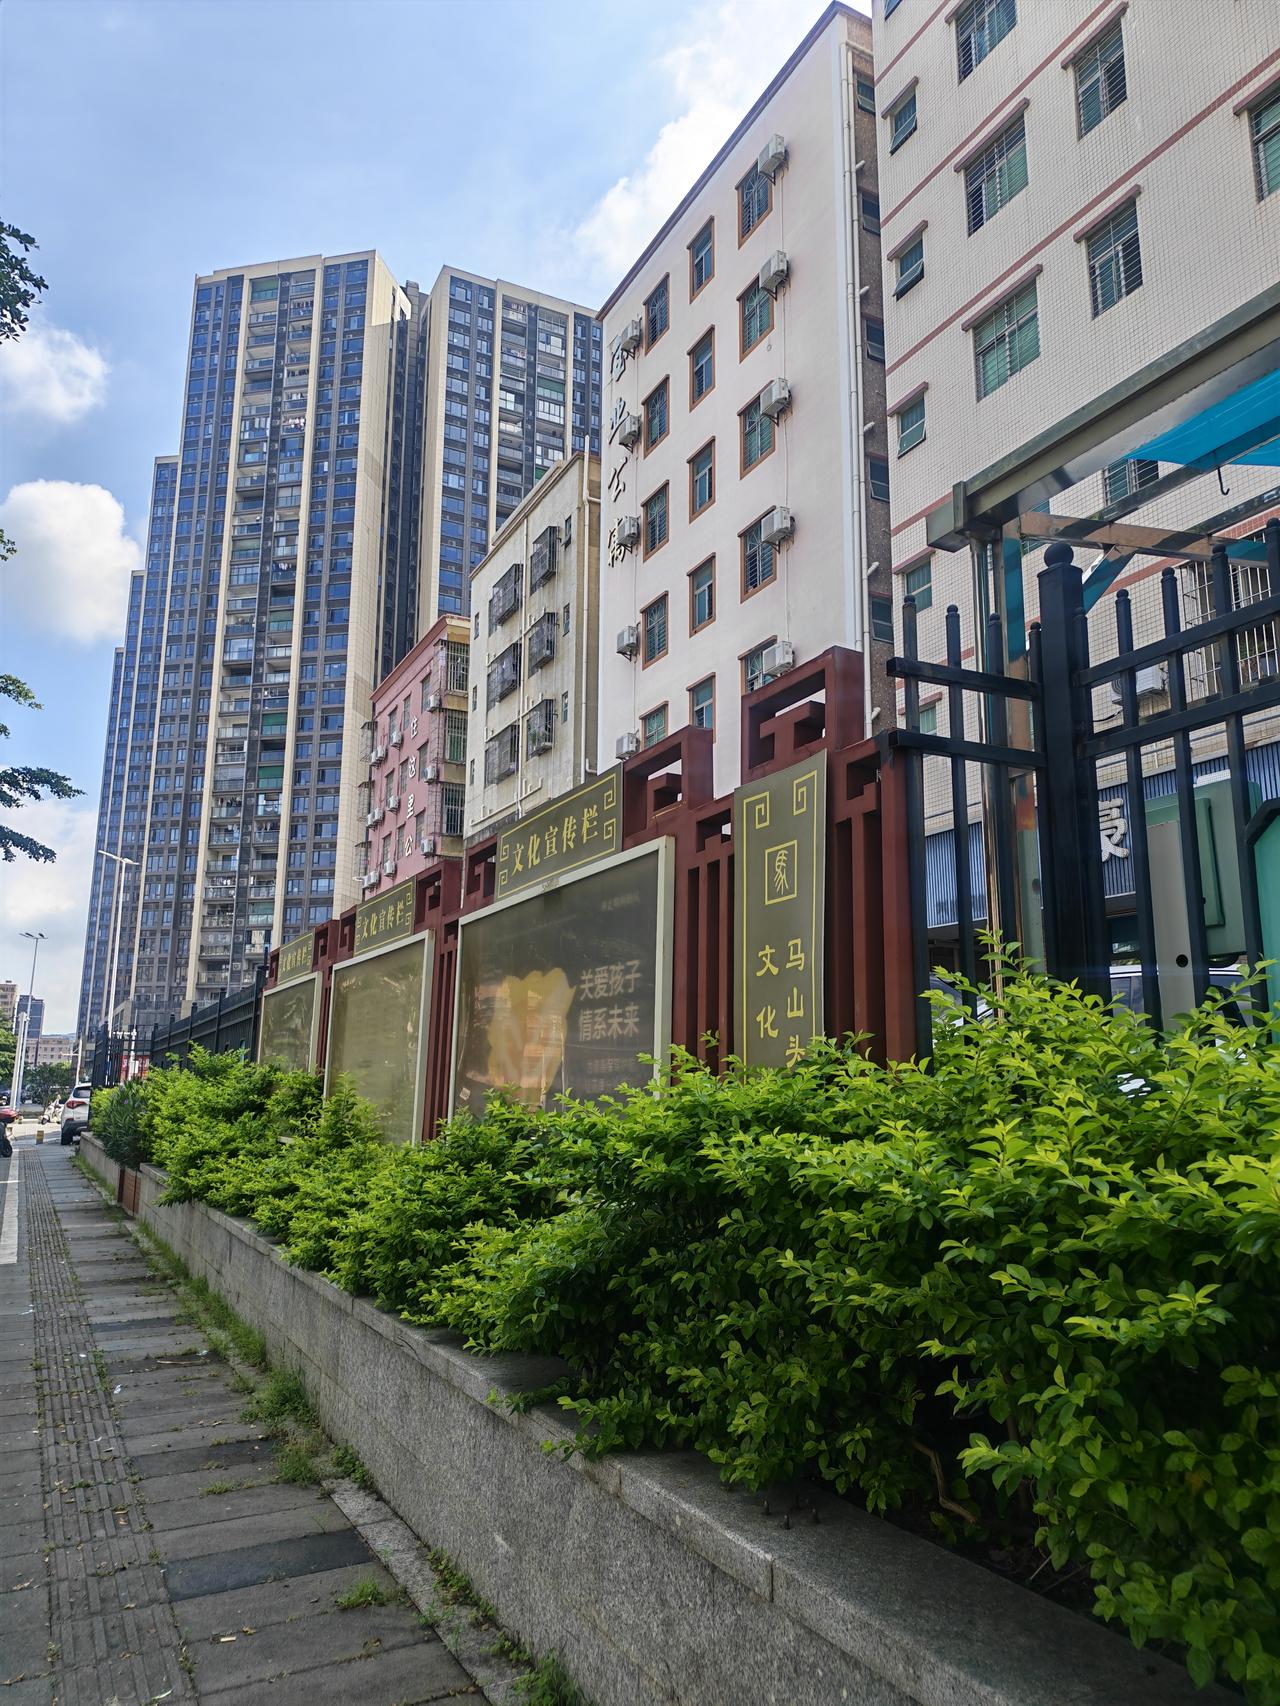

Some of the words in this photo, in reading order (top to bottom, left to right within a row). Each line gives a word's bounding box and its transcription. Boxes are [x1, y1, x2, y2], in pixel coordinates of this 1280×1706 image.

[404, 715, 419, 879] 住这里公
[511, 804, 599, 877] 文化宣传栏
[361, 899, 405, 941] 文化宣传栏
[579, 959, 642, 1001] 关爱孩子
[755, 944, 779, 1039] 文化
[785, 938, 806, 1069] 马山头
[578, 1002, 641, 1042] 情系未来
